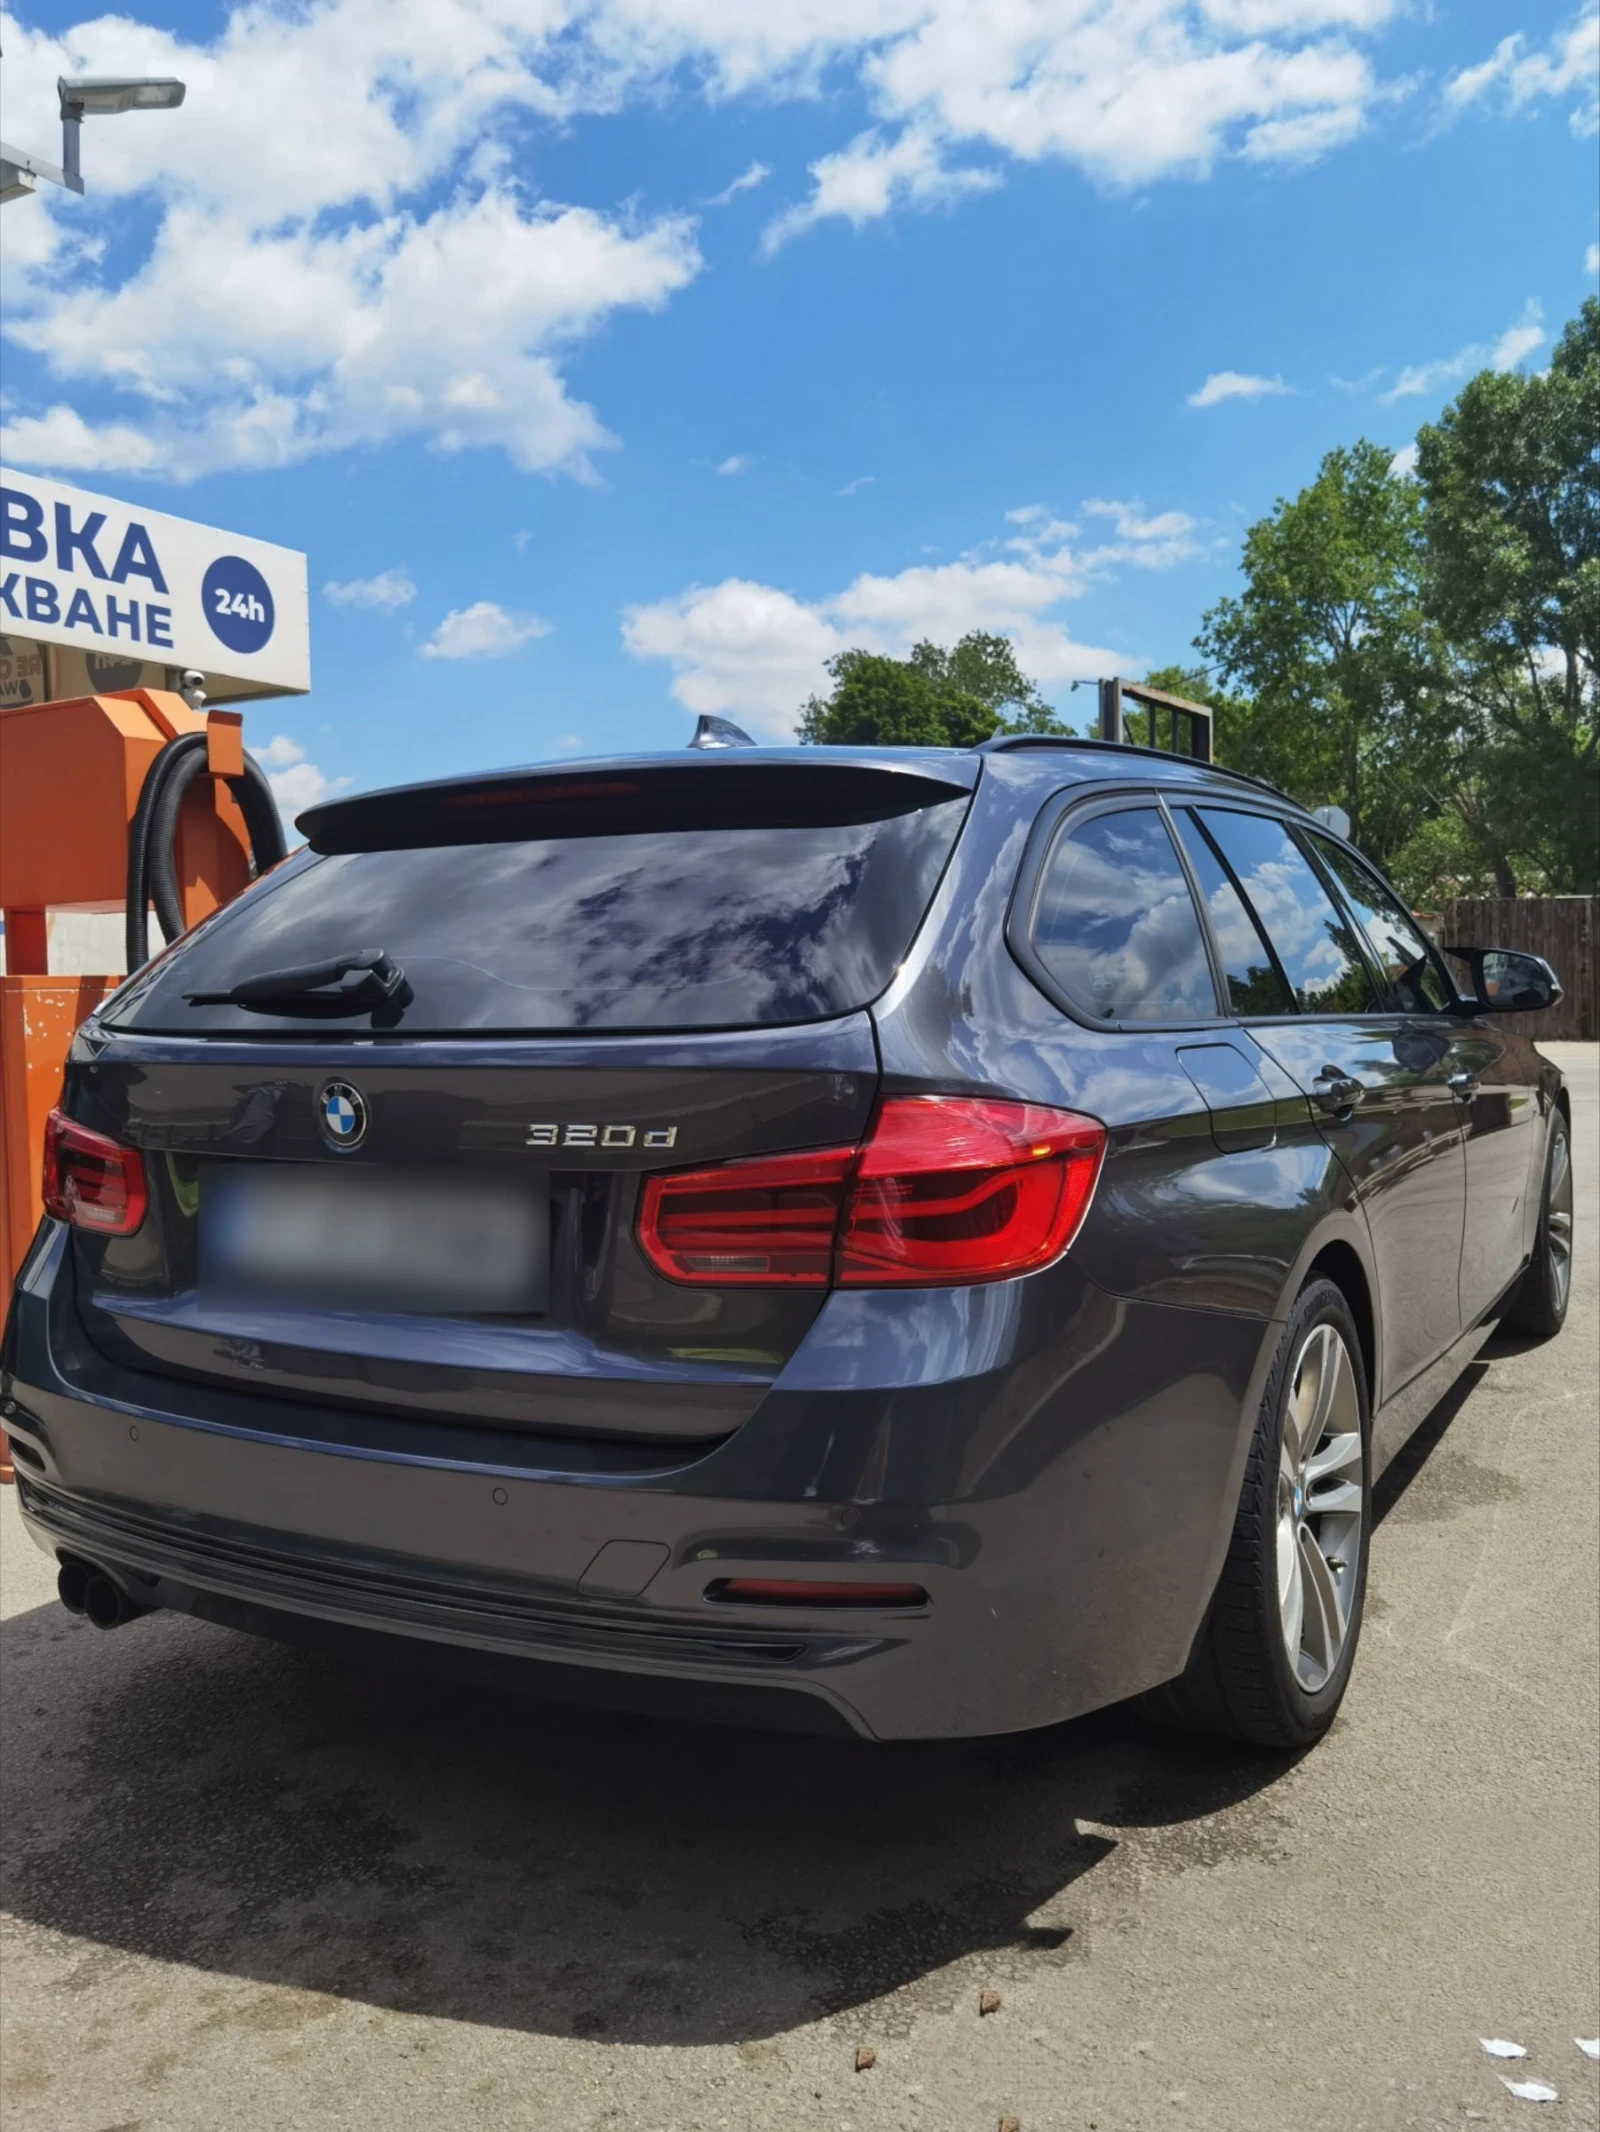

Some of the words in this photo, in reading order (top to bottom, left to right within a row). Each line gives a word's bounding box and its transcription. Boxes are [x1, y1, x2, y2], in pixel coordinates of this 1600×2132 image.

[0, 487, 169, 594] ВКА
[214, 588, 265, 623] 24h
[525, 1124, 678, 1148] 320d
